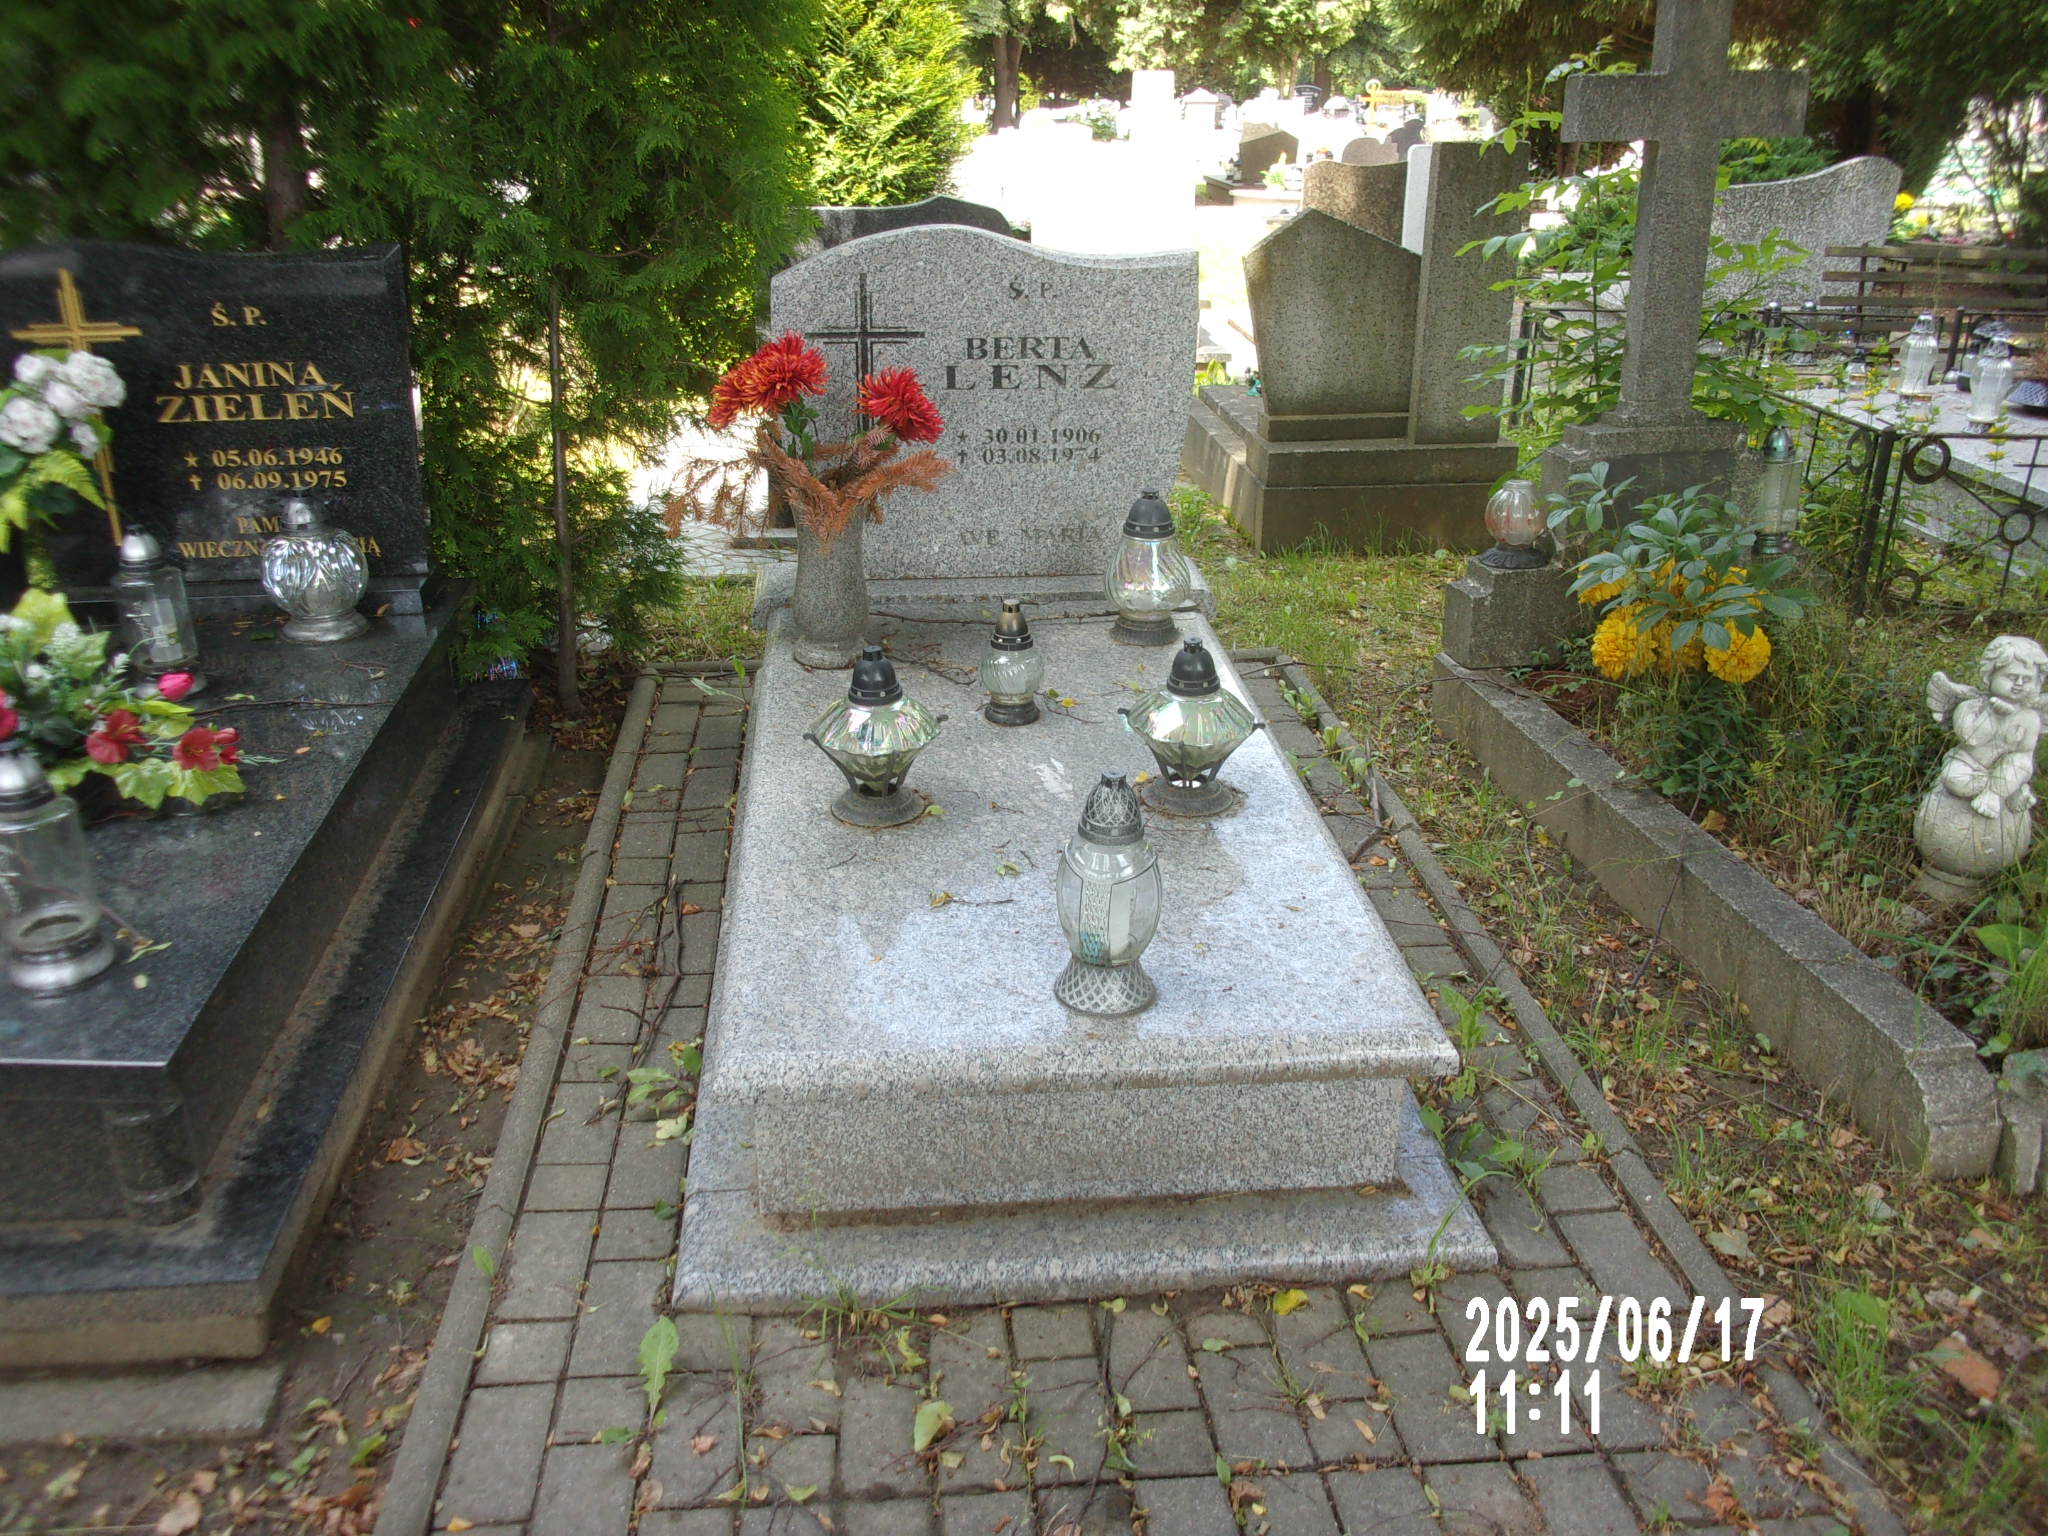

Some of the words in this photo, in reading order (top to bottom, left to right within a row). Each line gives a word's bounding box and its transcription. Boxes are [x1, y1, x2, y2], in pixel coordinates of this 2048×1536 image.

[243, 306, 267, 326] P.
[966, 336, 1096, 361] BERTA
[175, 361, 328, 389] JANINA
[943, 363, 1120, 391] LENZ
[156, 384, 354, 423] ZIELEŃ
[983, 427, 1101, 446] 30.01.1906
[211, 447, 344, 468] 05.06.1946
[216, 470, 348, 490] 06.09.1975
